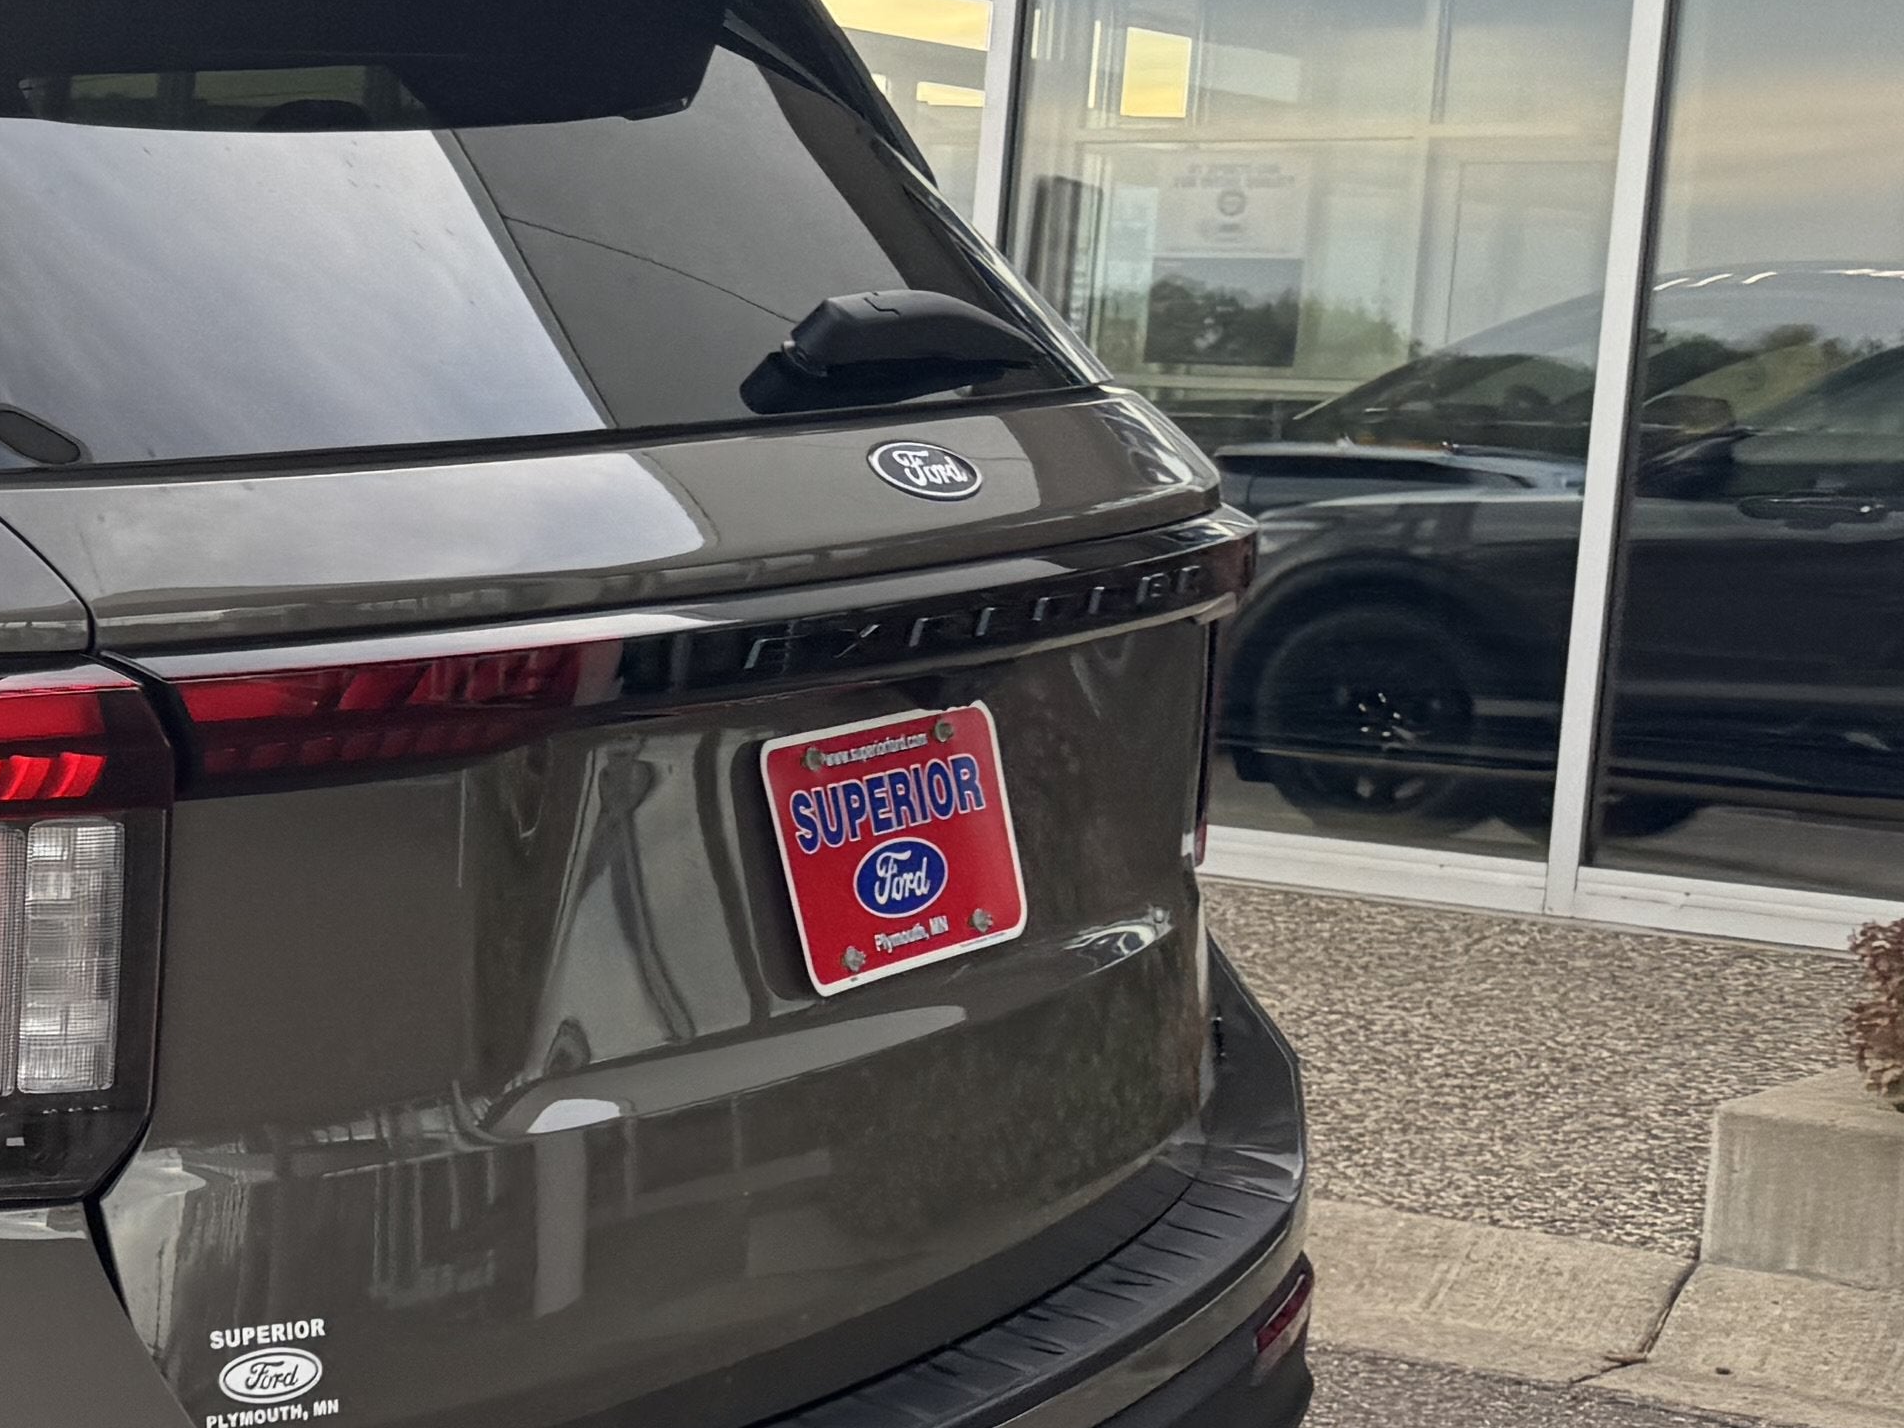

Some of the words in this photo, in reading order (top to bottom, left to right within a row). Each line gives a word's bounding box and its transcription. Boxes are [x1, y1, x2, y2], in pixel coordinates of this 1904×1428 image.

[891, 450, 969, 487] Ford
[789, 753, 986, 855] SUPERIOR
[874, 850, 931, 905] Ford
[929, 915, 949, 935] MN
[209, 1318, 326, 1350] SUPERIOR
[245, 1360, 299, 1390] Ford
[313, 1399, 339, 1417] MN
